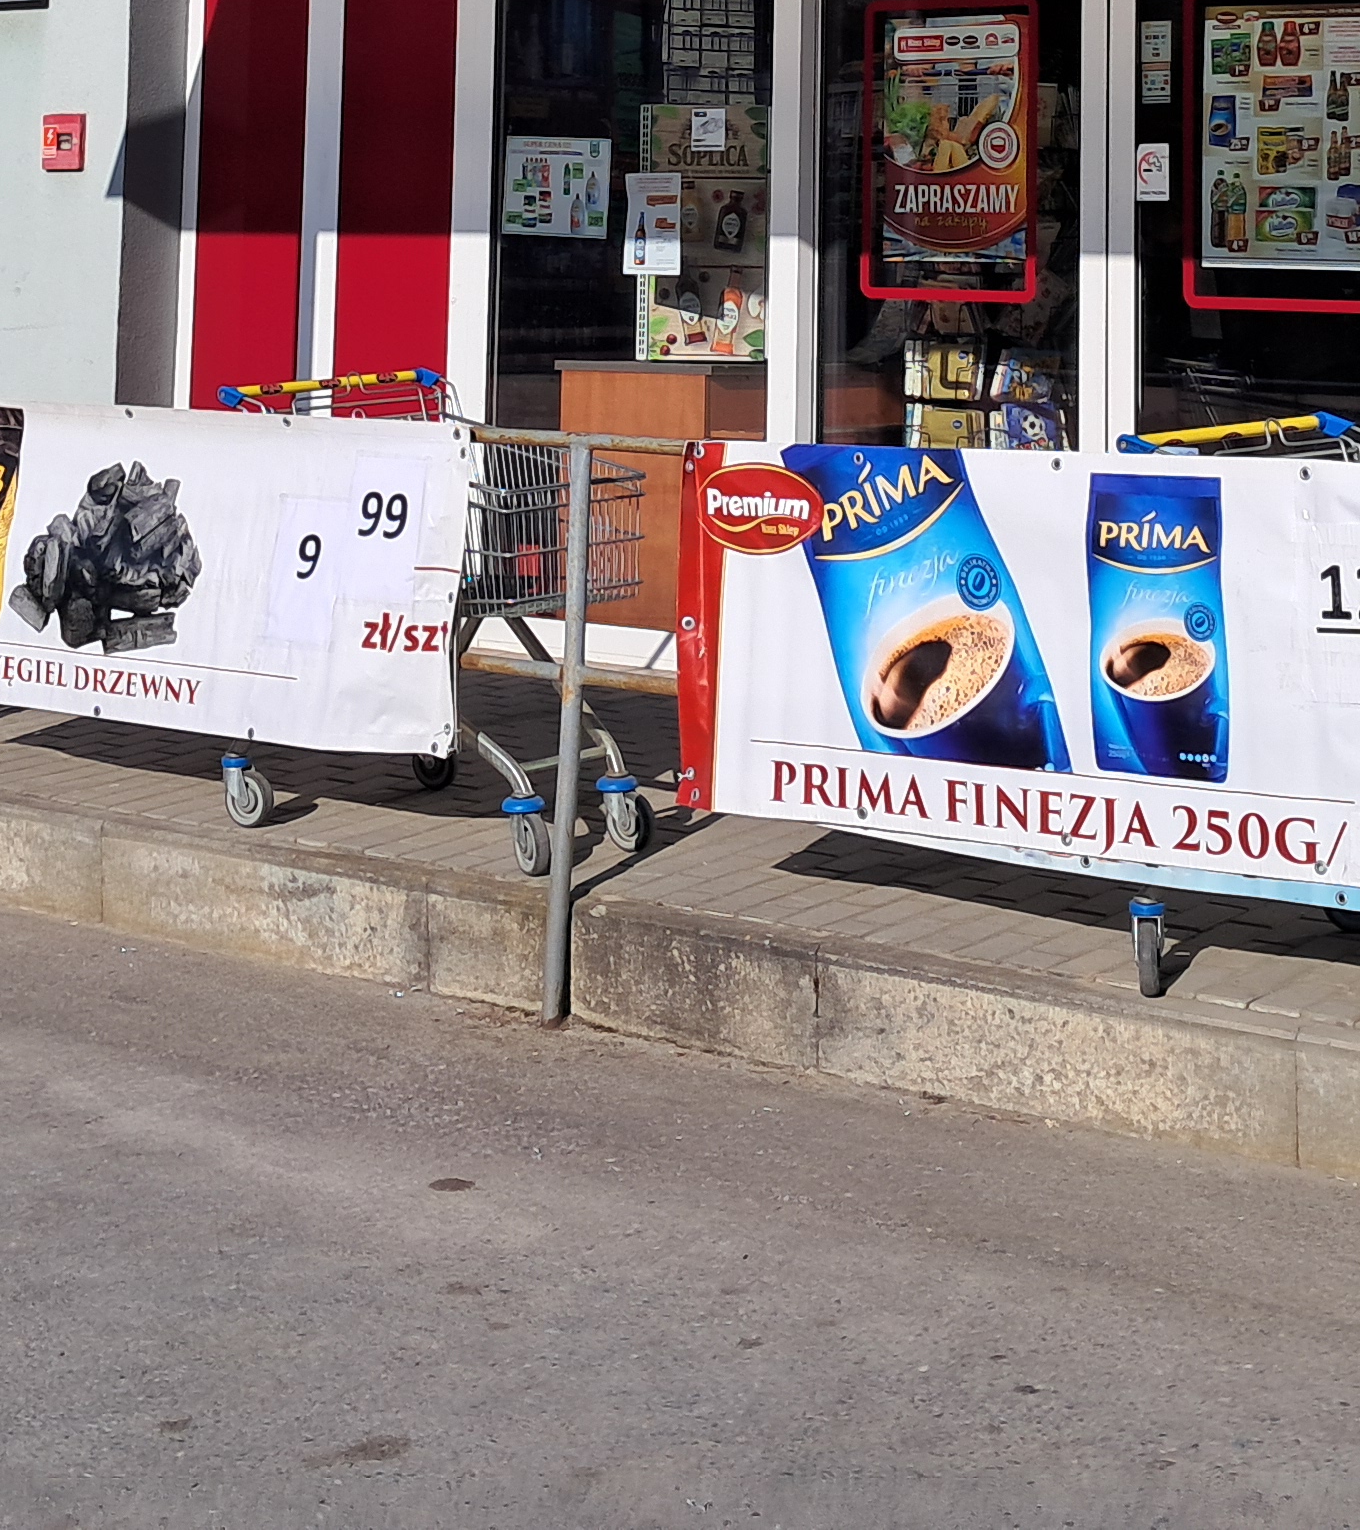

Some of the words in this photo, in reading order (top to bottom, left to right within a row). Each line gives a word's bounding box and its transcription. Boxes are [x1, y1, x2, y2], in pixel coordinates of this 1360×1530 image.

[667, 143, 750, 167] SOPLICA
[893, 184, 1020, 214] ZAPRASZAMY
[706, 487, 811, 521] Premium
[296, 534, 322, 580] 9
[358, 491, 409, 539] 99
[865, 547, 959, 618] finezja
[361, 612, 449, 655] zł/szt
[73, 664, 202, 706] DRZEWNY
[770, 758, 933, 821] PRIMA
[944, 778, 1161, 856] FINEZJA
[1171, 806, 1348, 868] 250G/
